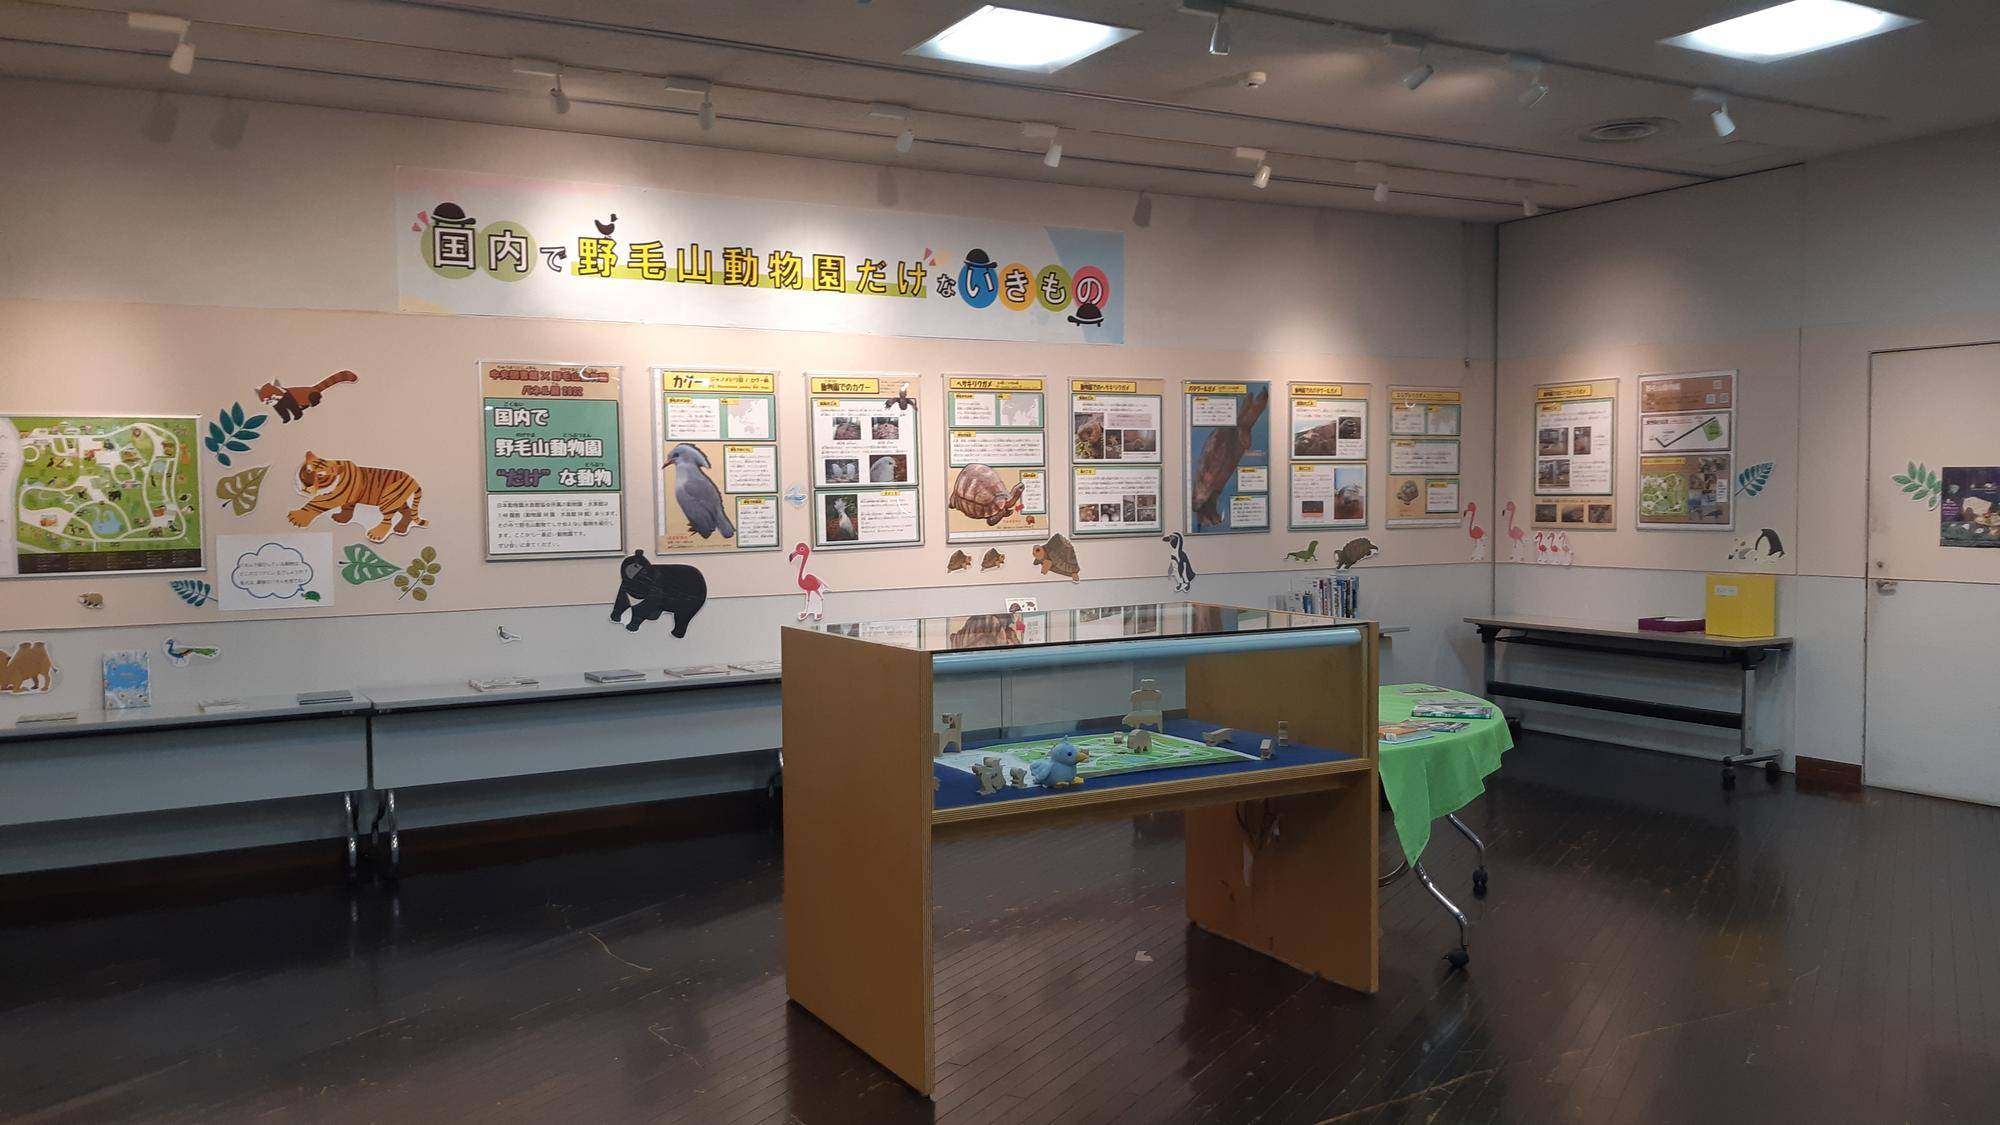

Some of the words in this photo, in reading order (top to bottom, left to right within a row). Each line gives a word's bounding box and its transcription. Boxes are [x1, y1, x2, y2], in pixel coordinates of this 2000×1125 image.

[673, 374, 703, 389] カグー
[494, 407, 549, 427] 国内で
[495, 438, 603, 457] 野毛山動物園
